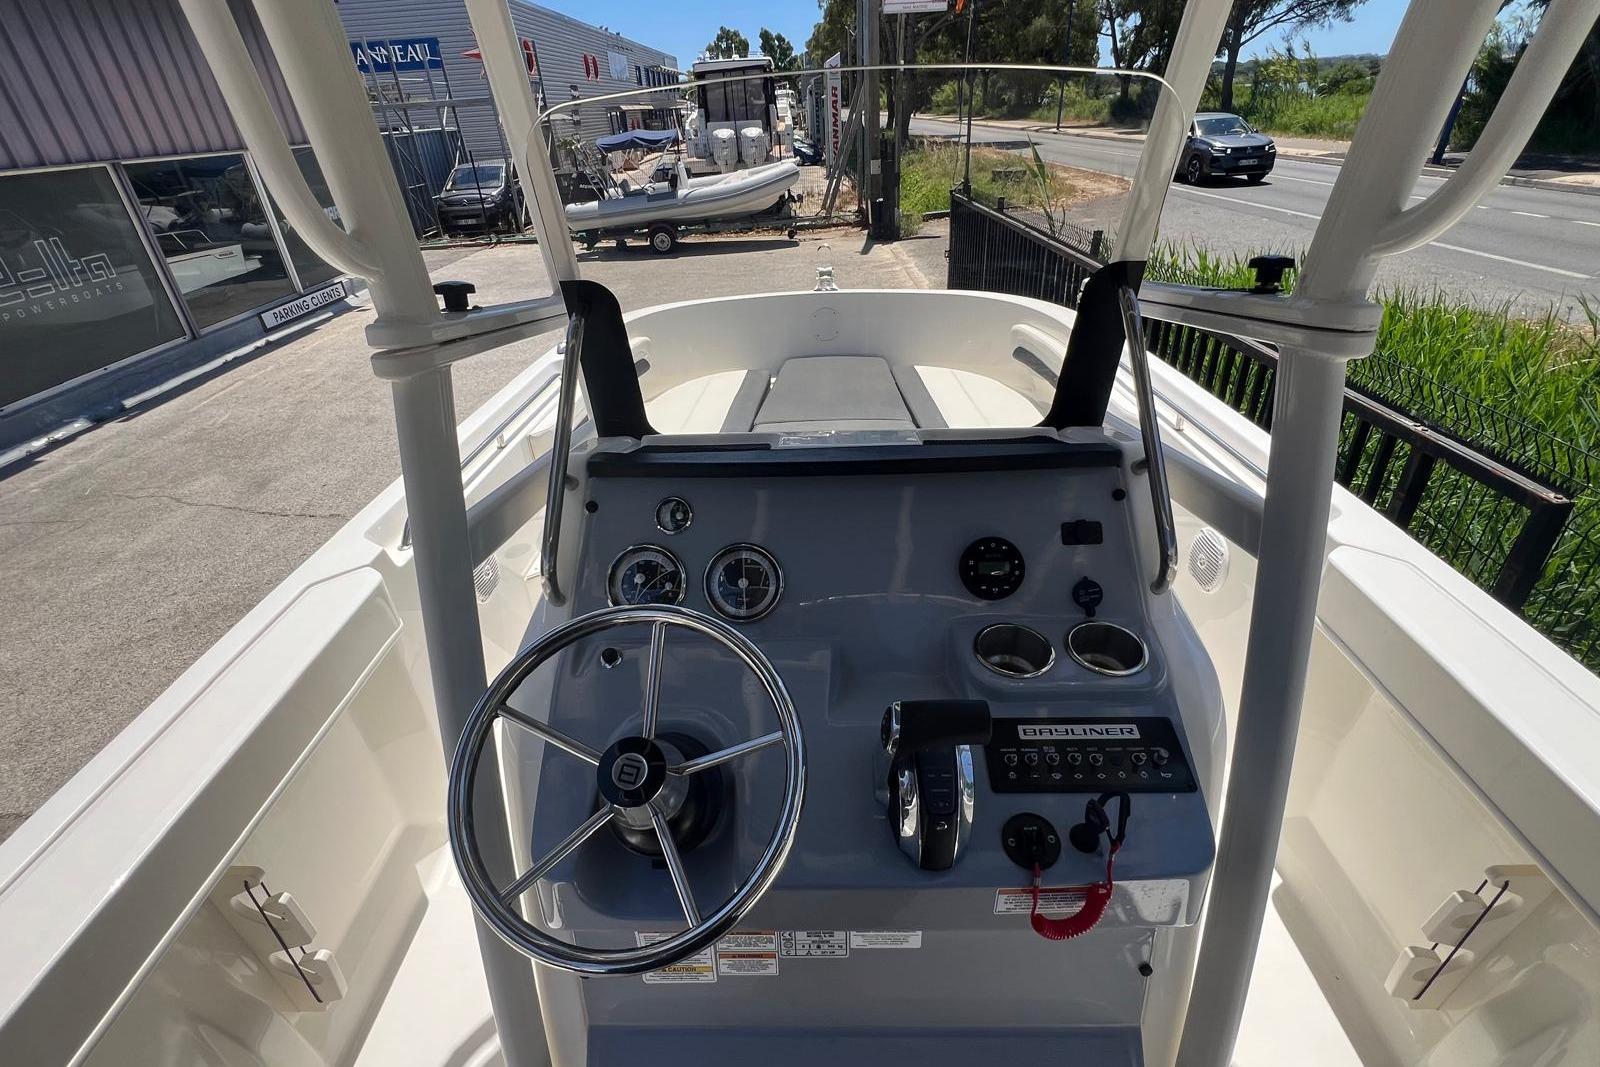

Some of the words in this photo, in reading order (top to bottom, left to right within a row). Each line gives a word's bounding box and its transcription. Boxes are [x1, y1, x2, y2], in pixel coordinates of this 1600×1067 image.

[2, 282, 123, 321] POWERBOATS
[272, 300, 310, 323] PARKING
[310, 287, 341, 306] CLIENTS
[1022, 727, 1136, 737] BAYLINER
[667, 965, 697, 973] CAUTION
